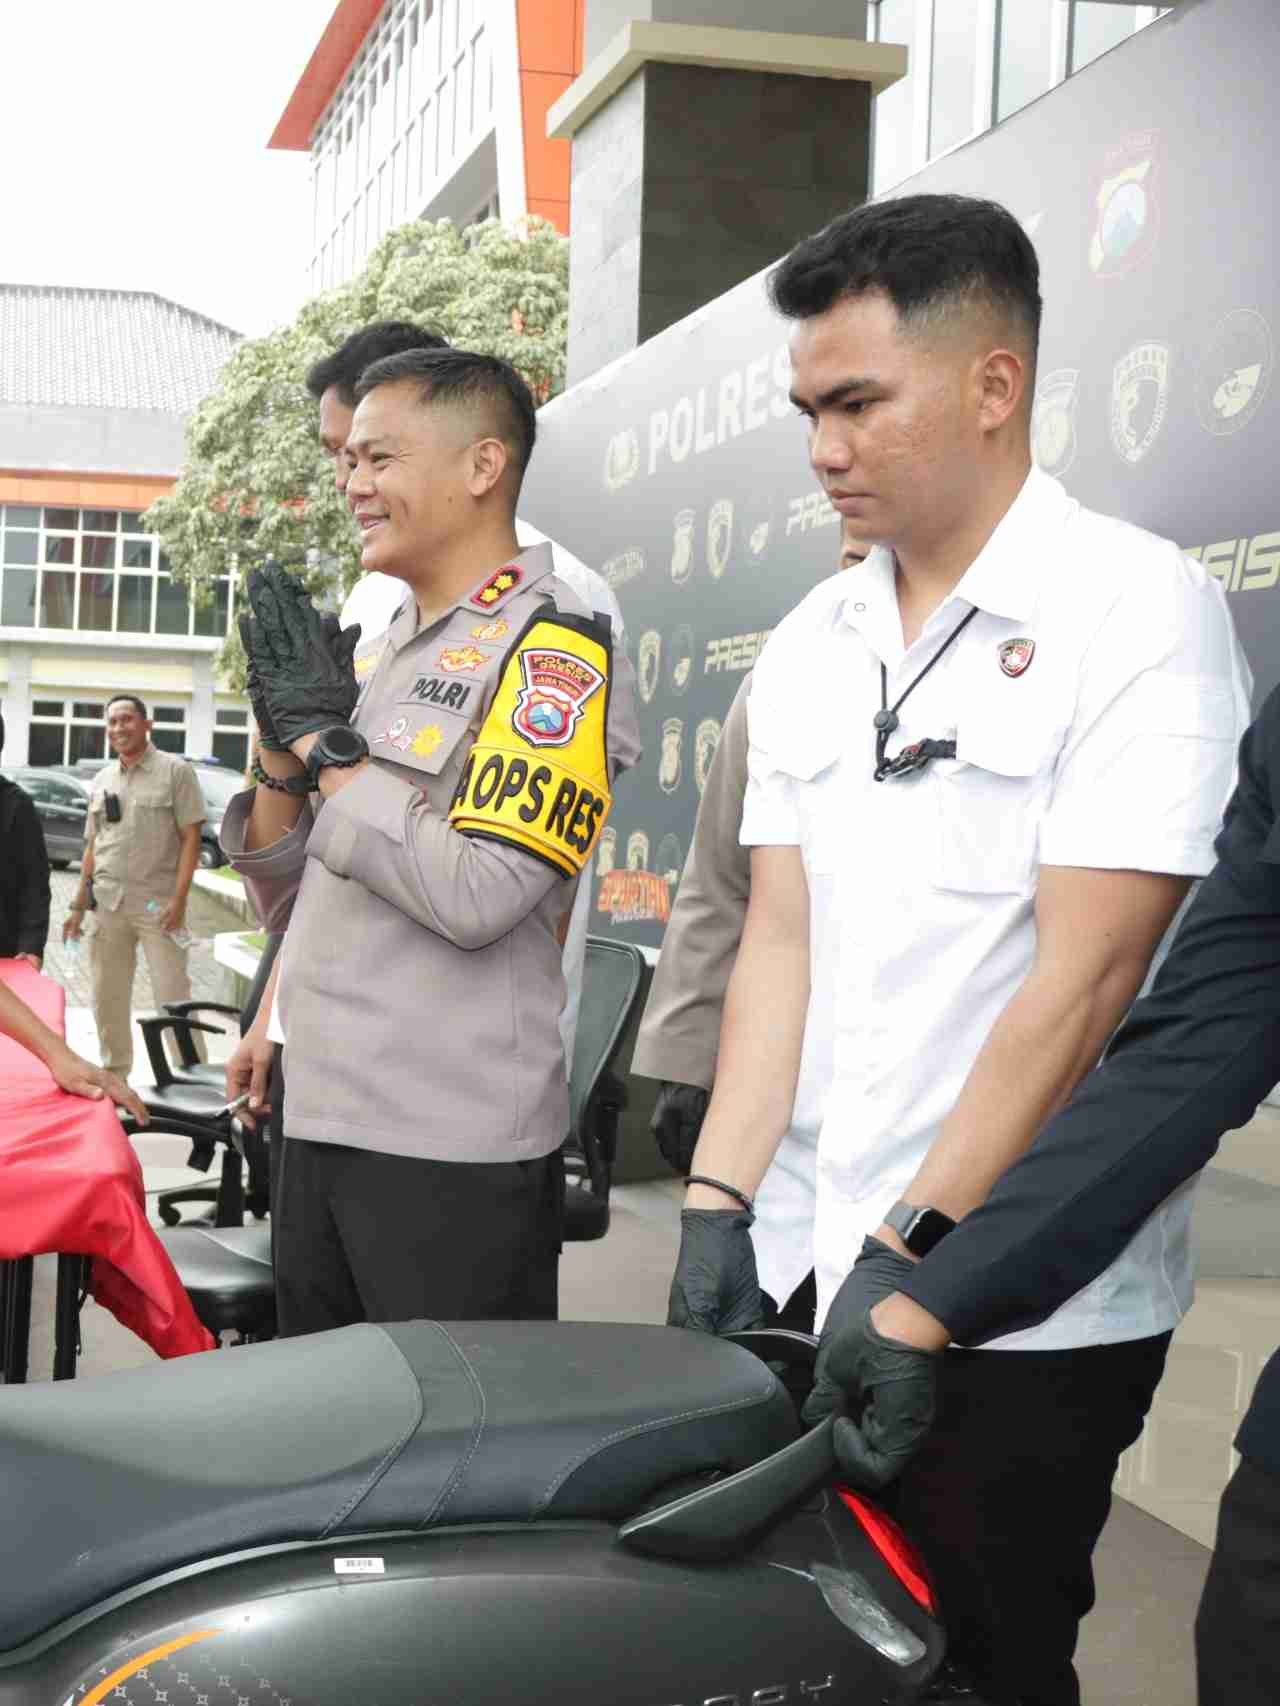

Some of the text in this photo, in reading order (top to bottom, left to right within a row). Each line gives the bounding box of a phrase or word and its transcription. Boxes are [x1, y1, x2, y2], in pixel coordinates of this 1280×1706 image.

[408, 678, 471, 710] POLRI
[472, 753, 552, 823] OPS
[545, 777, 604, 855] RES
